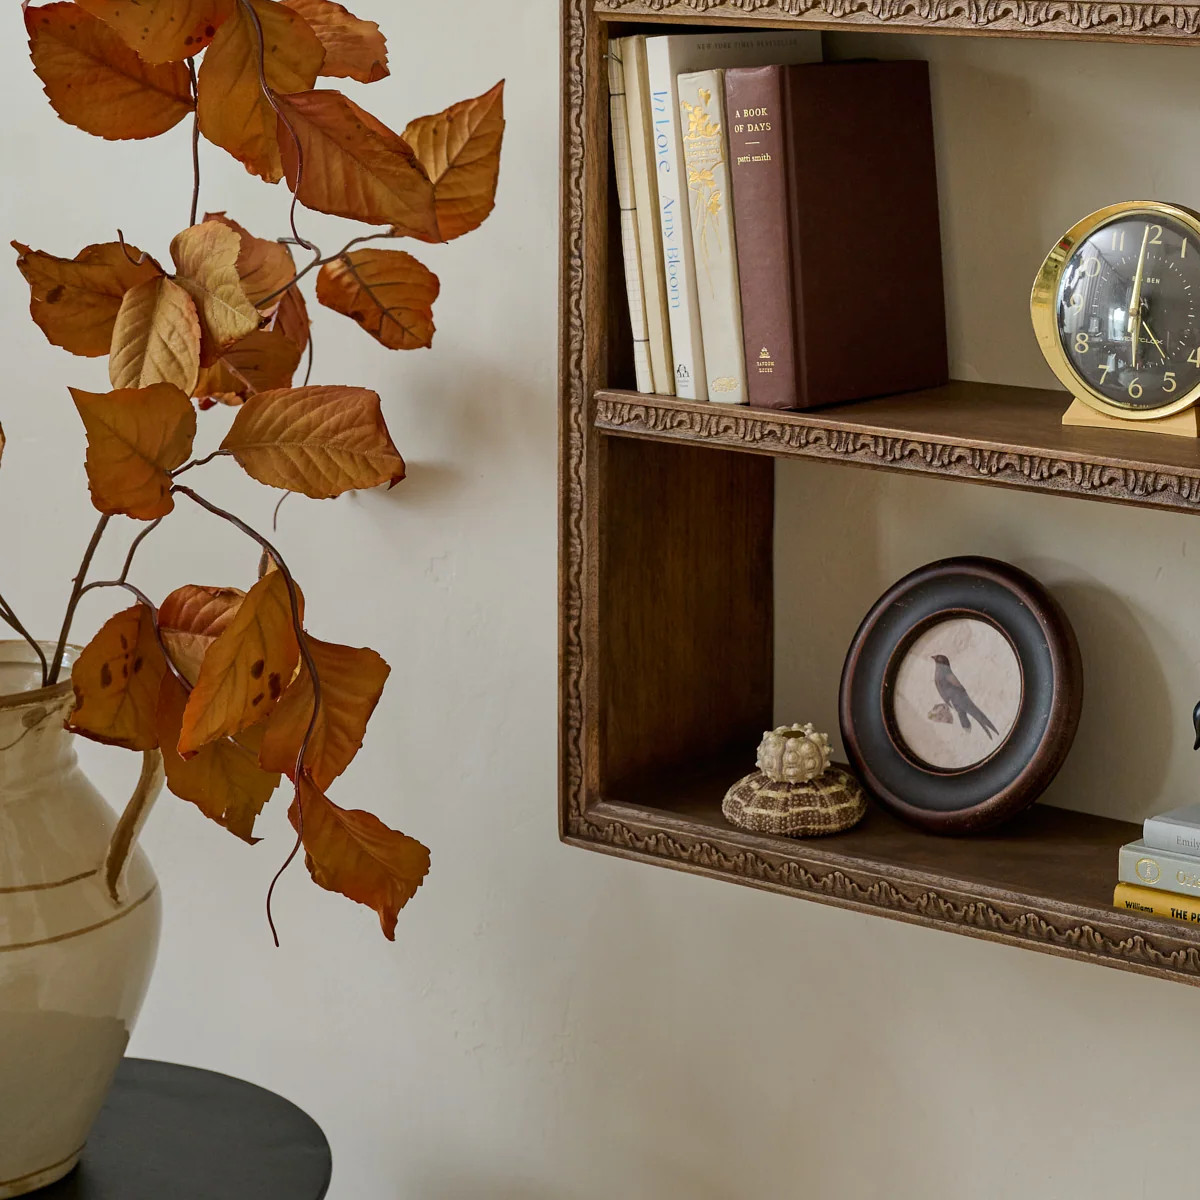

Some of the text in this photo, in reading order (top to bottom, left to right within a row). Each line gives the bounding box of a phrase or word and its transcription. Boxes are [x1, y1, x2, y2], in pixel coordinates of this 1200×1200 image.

[735, 108, 768, 118] A BOOK
[653, 91, 671, 173] In Love
[734, 122, 772, 133] OF DAYS
[737, 152, 772, 166] patti smith
[1112, 231, 1125, 252] 11
[1143, 224, 1163, 245] 2
[662, 195, 681, 309] Amy Bloom
[1180, 237, 1188, 259] 1
[1070, 293, 1084, 316] 9
[1074, 332, 1089, 354] 8
[1098, 364, 1111, 385] 7
[1162, 372, 1177, 393] 5
[1128, 377, 1143, 399] 6
[1176, 835, 1200, 851] Emily
[1125, 900, 1154, 913] Williams
[1170, 907, 1188, 920] THE
